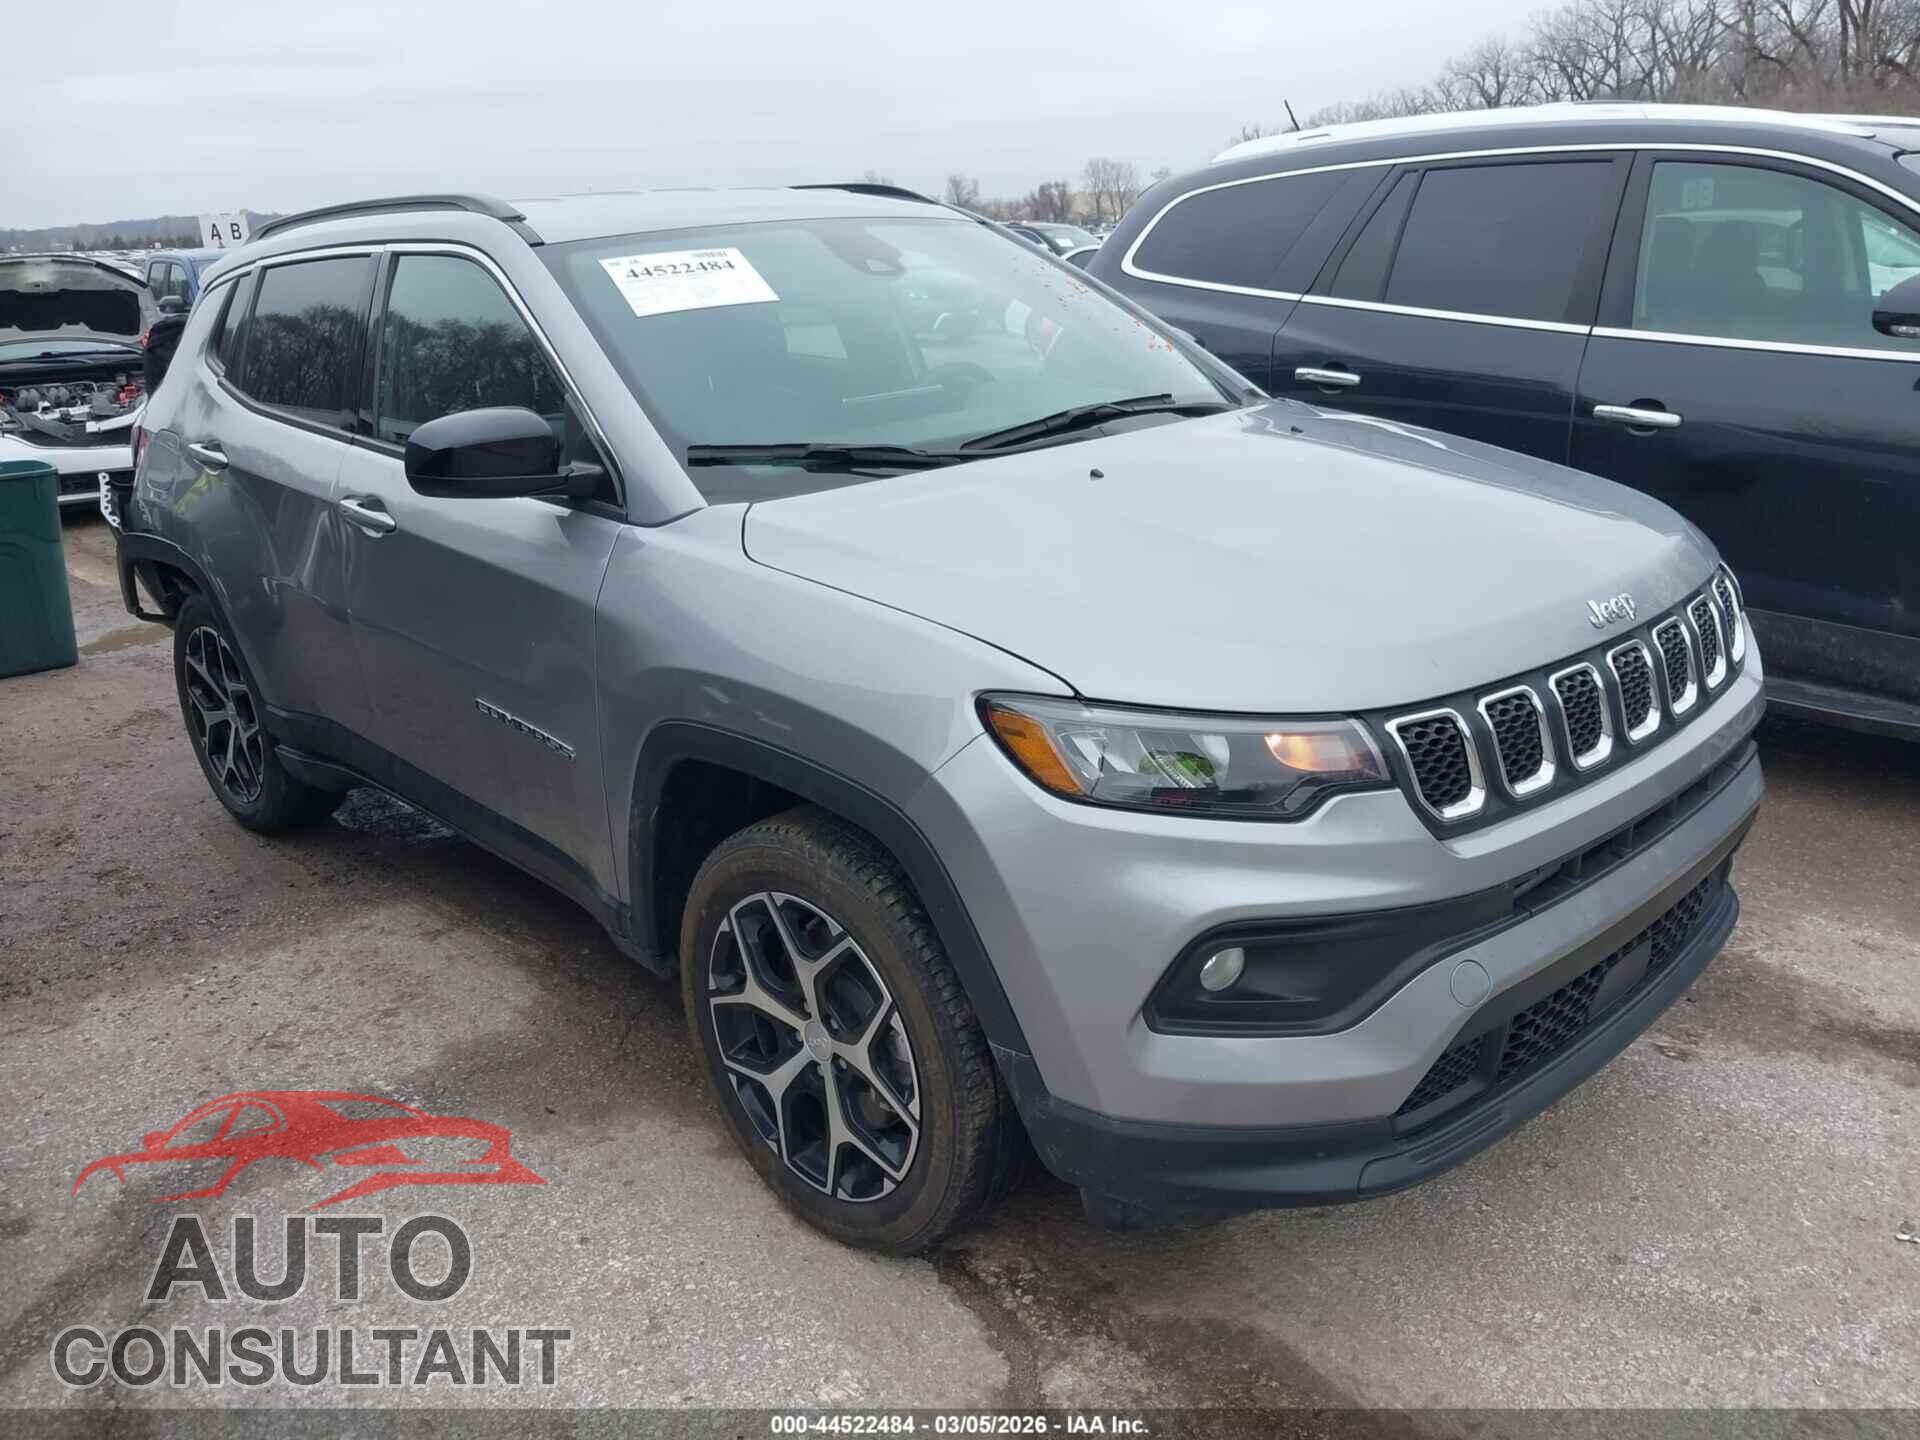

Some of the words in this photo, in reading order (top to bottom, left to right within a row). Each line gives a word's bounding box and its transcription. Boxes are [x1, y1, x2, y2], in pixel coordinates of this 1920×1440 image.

[211, 223, 222, 240] A
[230, 222, 242, 240] B
[626, 259, 736, 279] 44522484
[1586, 593, 1636, 627] Jeep
